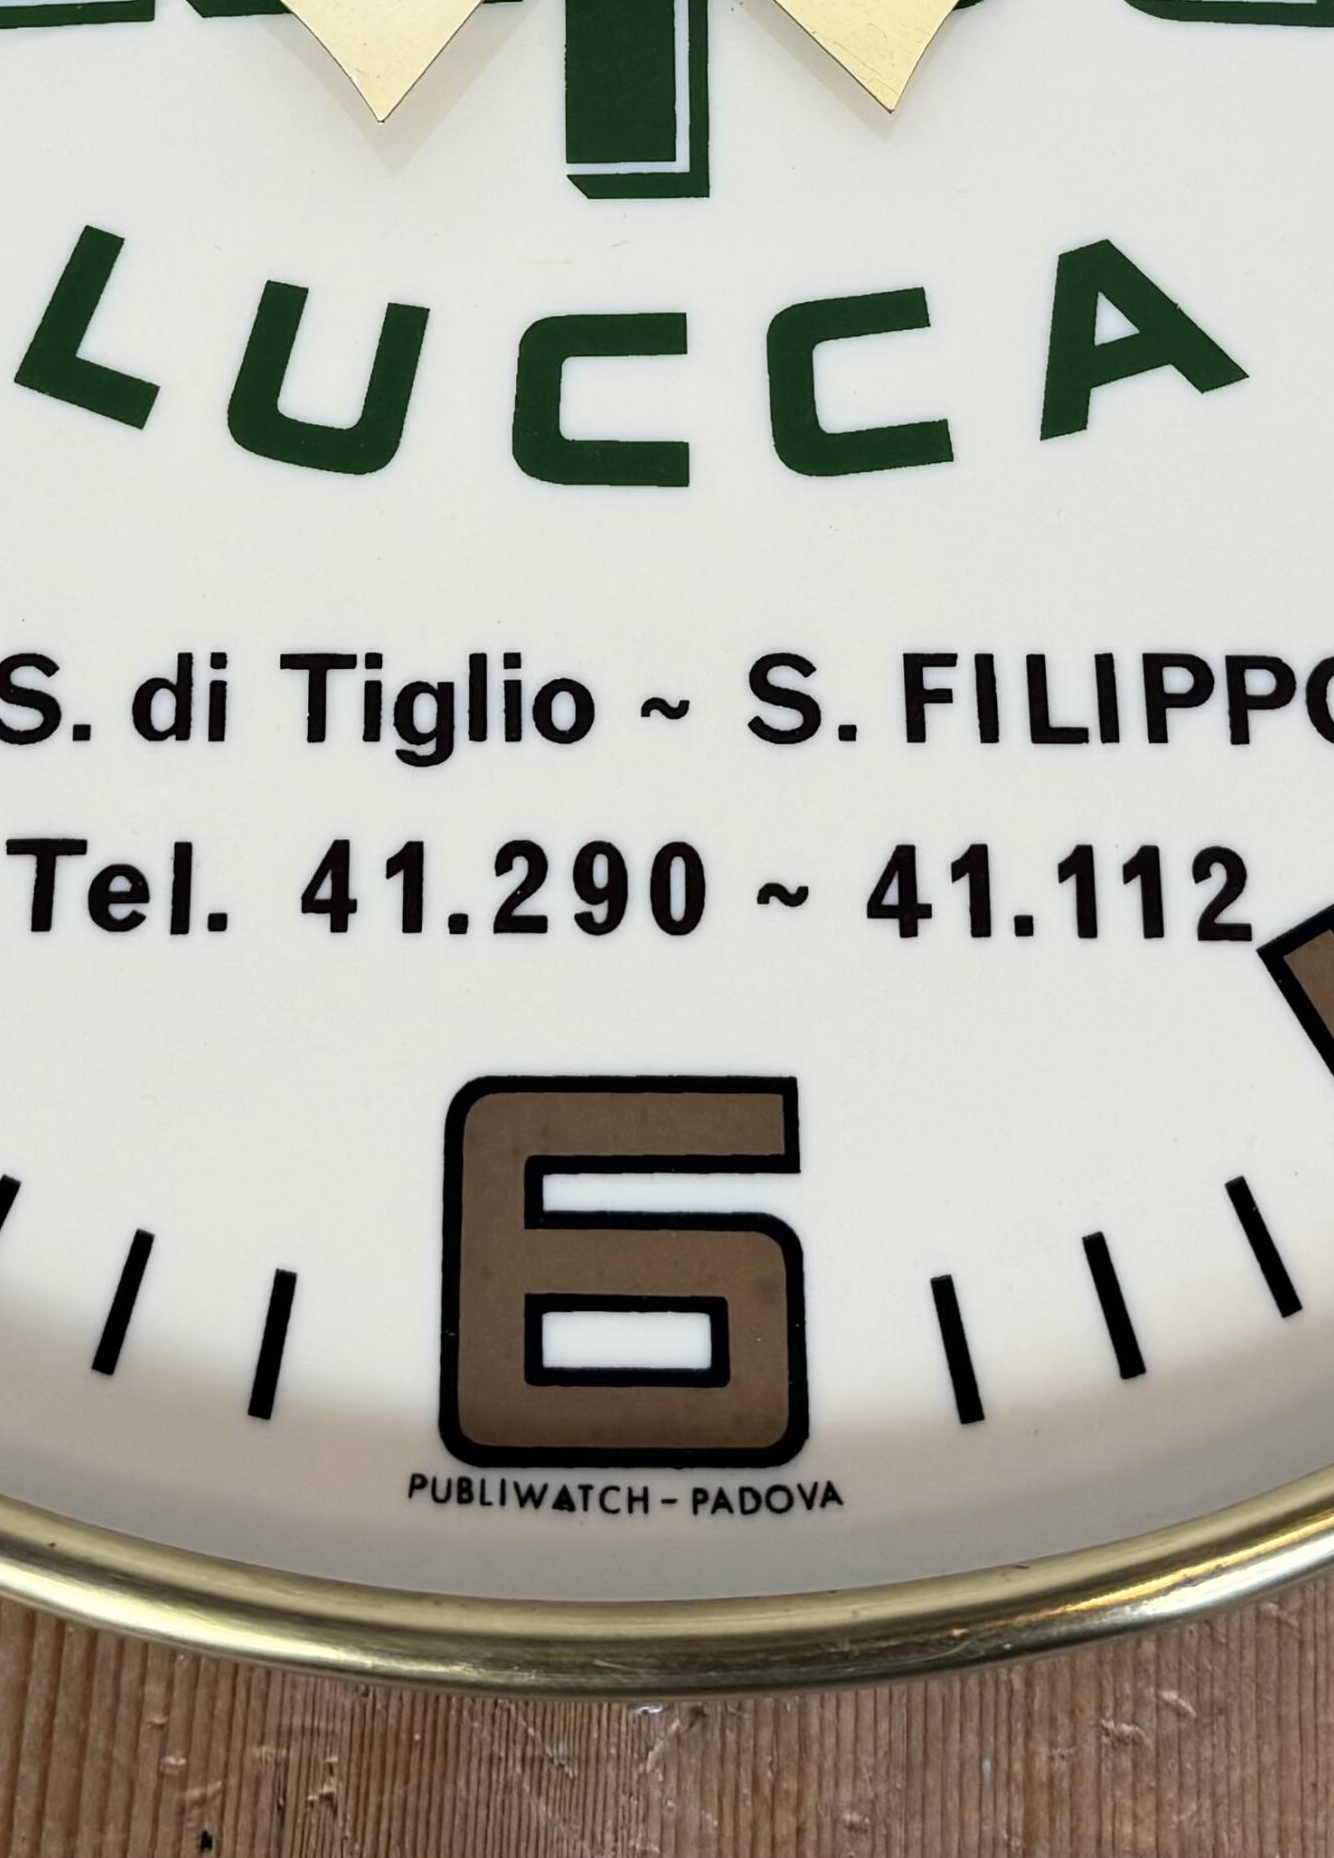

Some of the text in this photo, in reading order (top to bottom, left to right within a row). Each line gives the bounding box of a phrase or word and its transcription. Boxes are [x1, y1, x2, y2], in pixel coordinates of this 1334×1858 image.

[13, 225, 1250, 488] LUCCA
[131, 651, 228, 743] di
[279, 652, 596, 768] Tiglio
[747, 652, 858, 745] S.
[5, 837, 228, 936] Tel.
[300, 839, 706, 937] 41.290
[866, 843, 1253, 942] 41.112
[438, 1074, 811, 1469] 6
[691, 1480, 844, 1516] PADOVA
